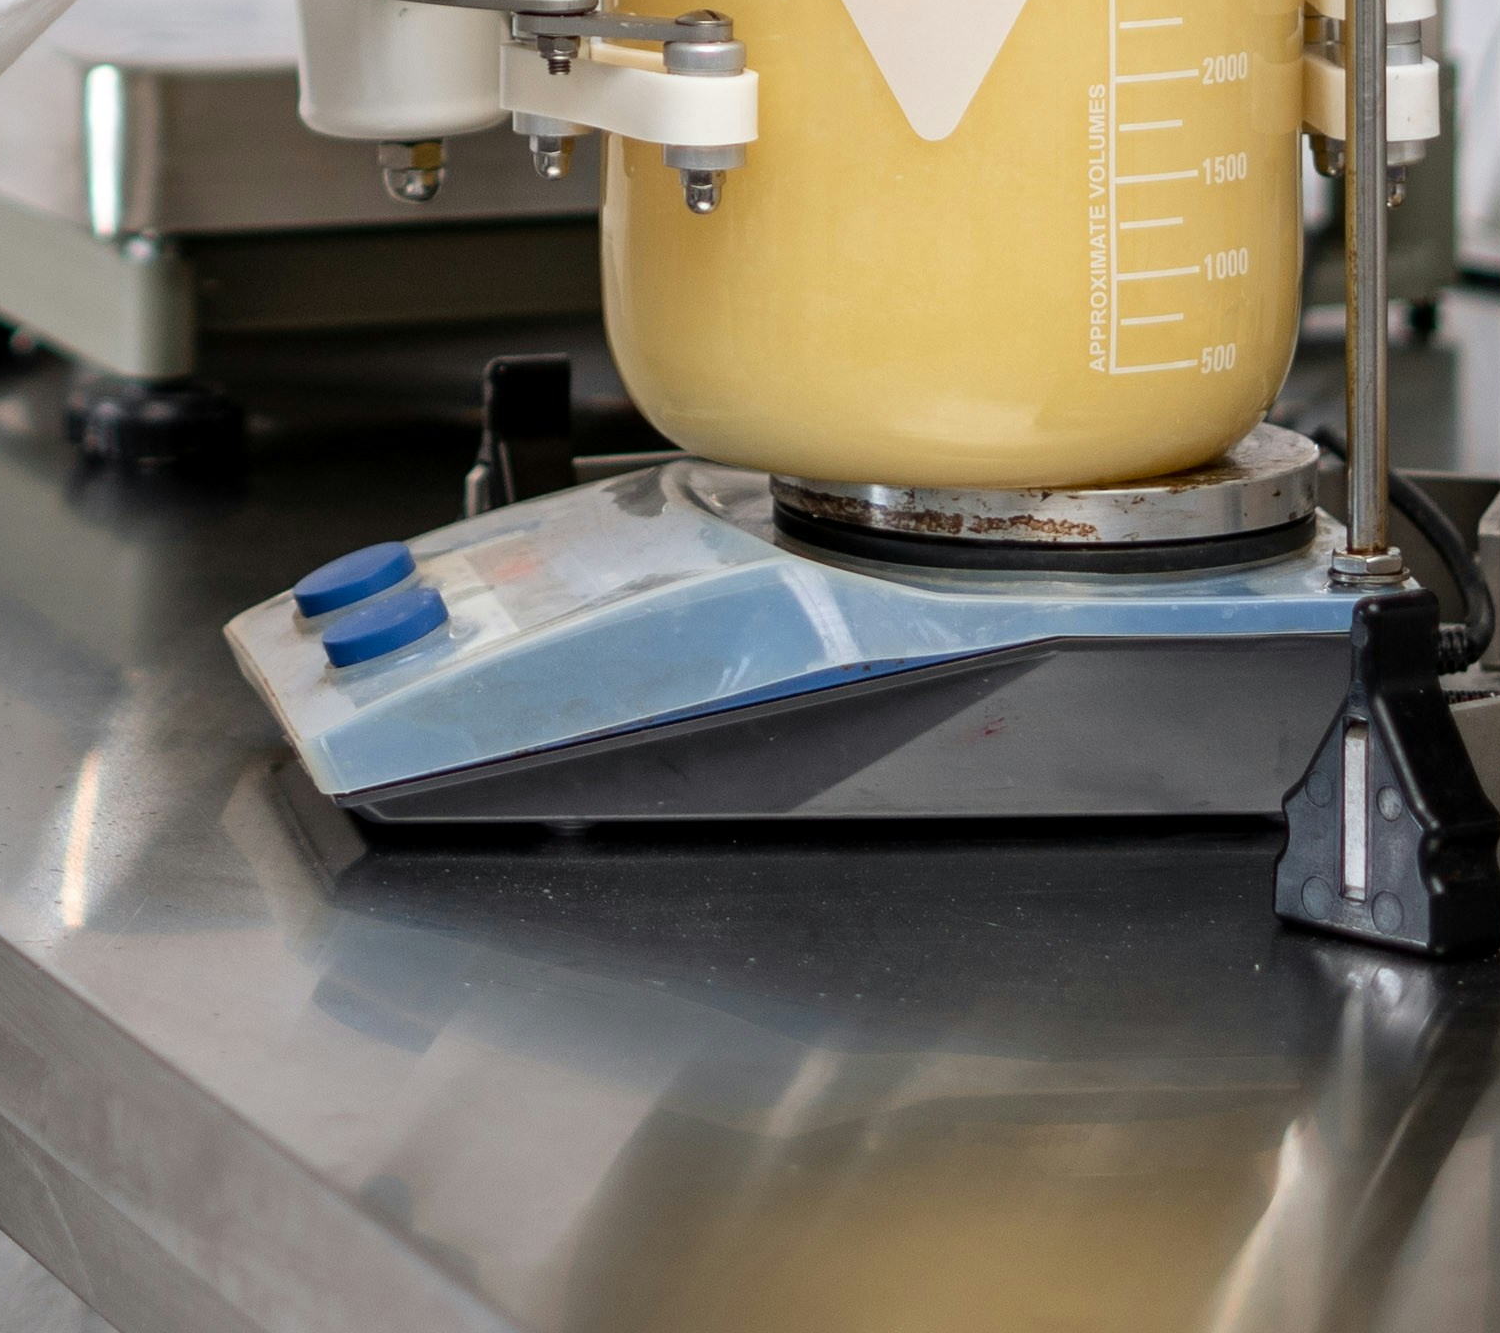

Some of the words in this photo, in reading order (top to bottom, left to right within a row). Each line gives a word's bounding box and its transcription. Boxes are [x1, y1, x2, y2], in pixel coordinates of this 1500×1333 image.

[1202, 51, 1248, 85] 2000
[1087, 83, 1106, 199] VOLUMES
[1202, 152, 1248, 185] 1500
[1204, 247, 1249, 282] 1000
[1088, 204, 1108, 373] APPROXIMATE
[1201, 343, 1236, 374] 500
